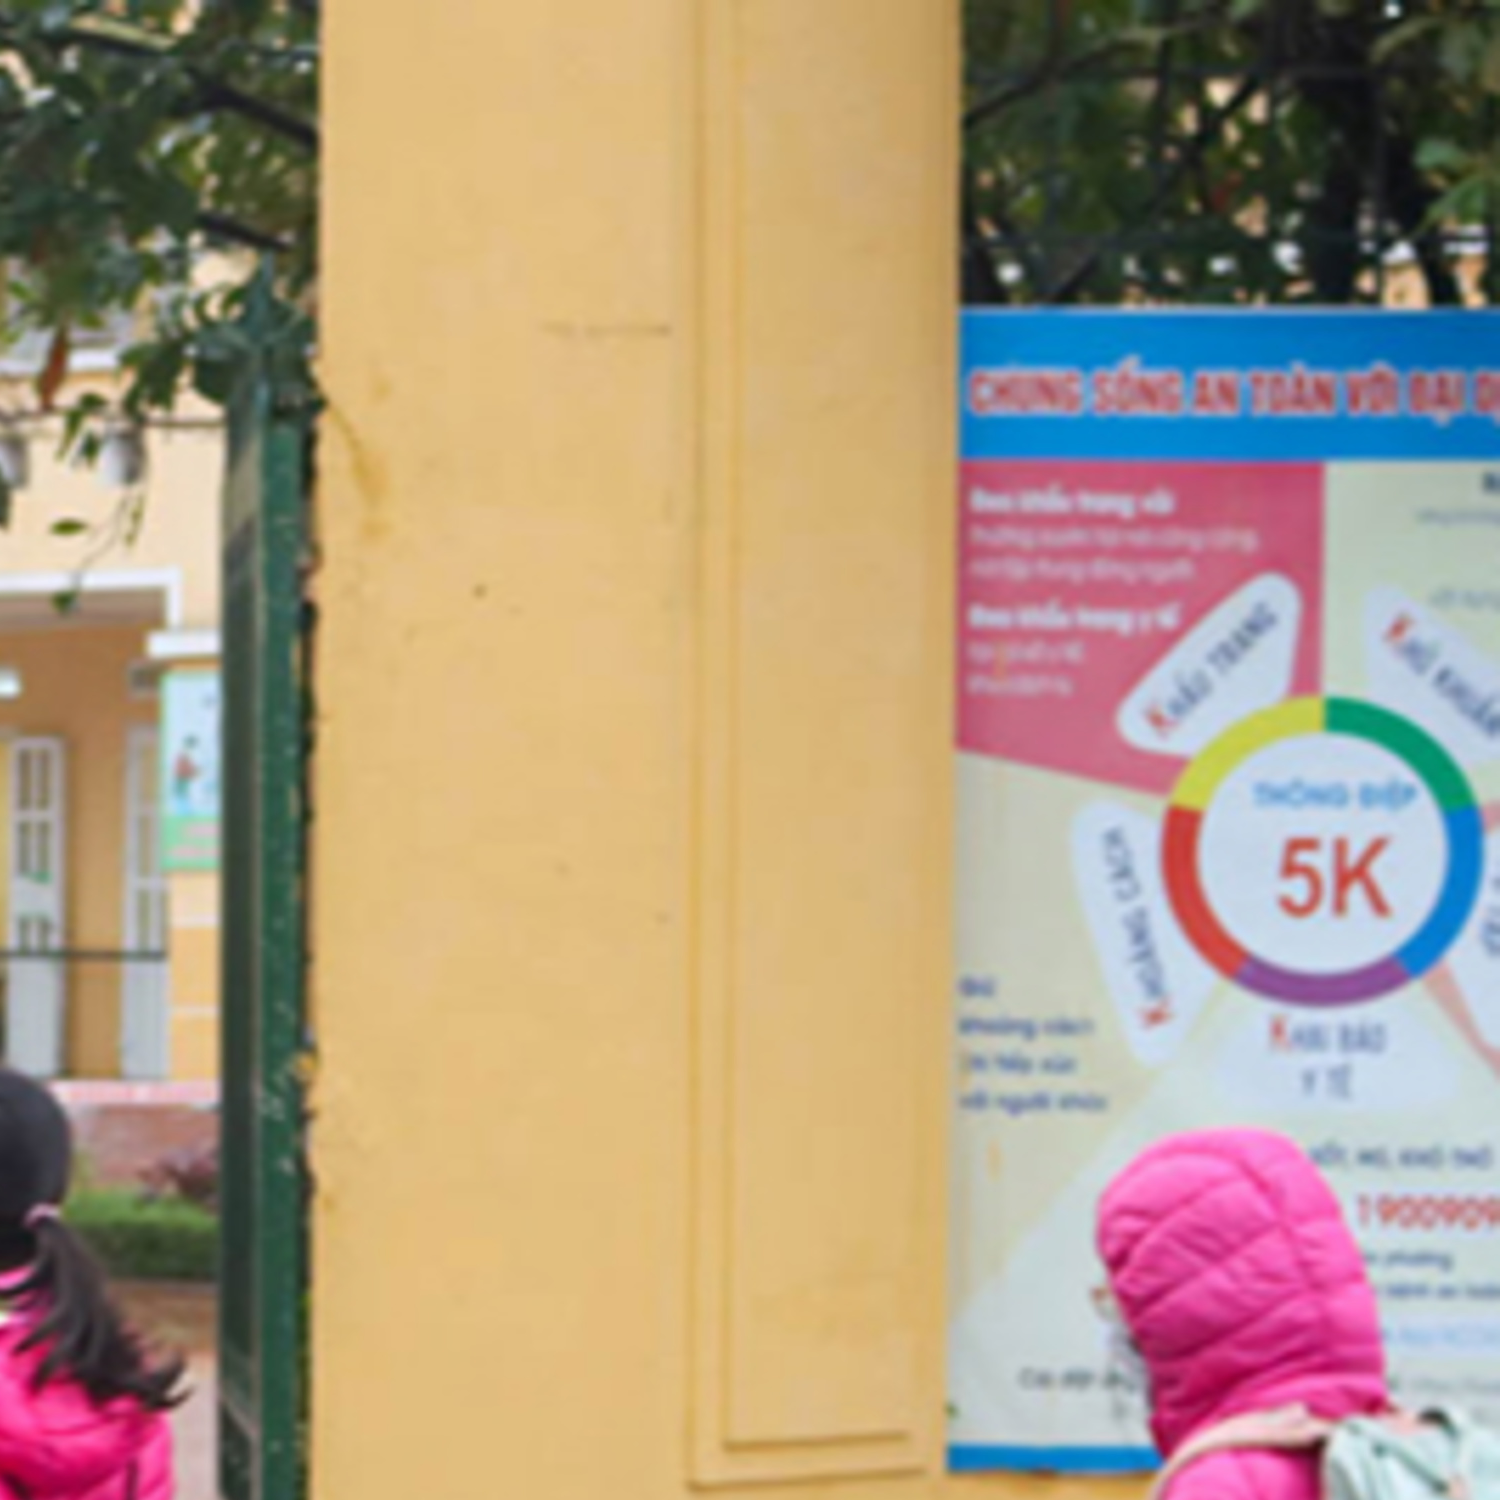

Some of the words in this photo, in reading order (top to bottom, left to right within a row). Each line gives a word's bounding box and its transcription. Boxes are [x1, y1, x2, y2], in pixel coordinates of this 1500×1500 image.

[1192, 370, 1238, 416] AN
[1250, 361, 1336, 416] TOÀN
[1277, 836, 1392, 919] 5K
